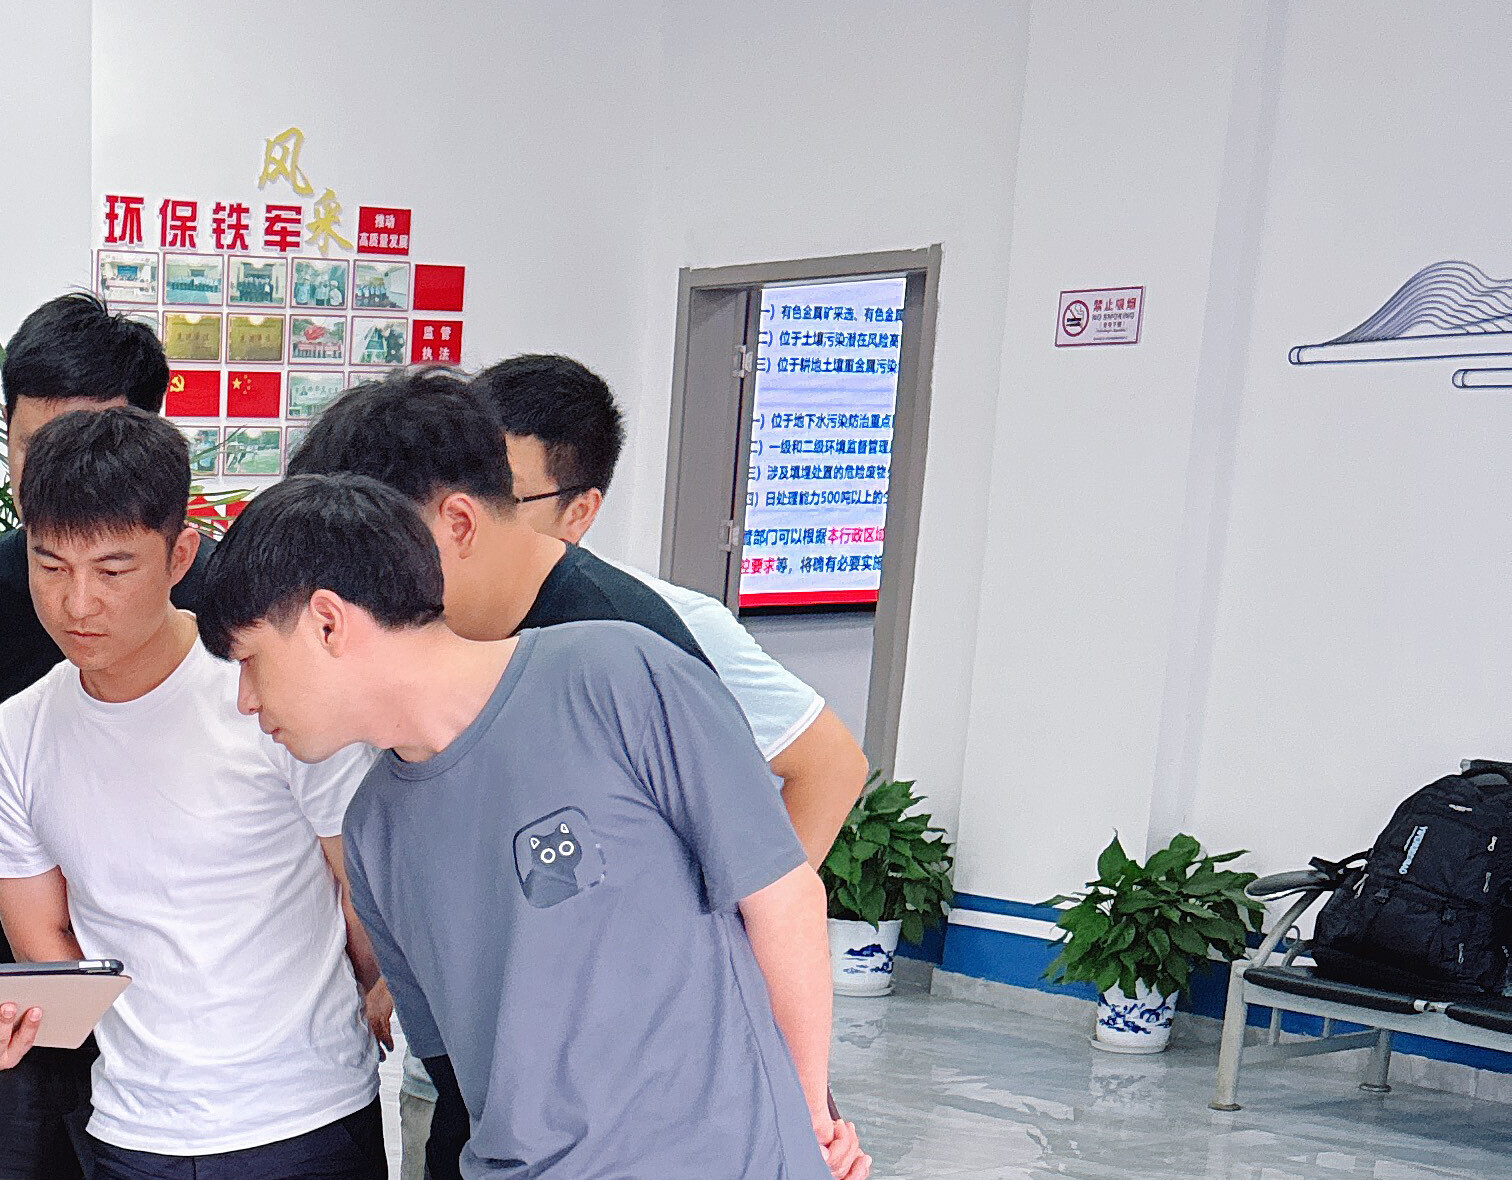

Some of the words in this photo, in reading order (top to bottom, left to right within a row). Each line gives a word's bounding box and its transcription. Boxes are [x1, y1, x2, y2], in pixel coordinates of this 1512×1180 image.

[105, 194, 302, 253] 环保铁军
[374, 213, 396, 229] 推动
[358, 232, 409, 249] 高质量发展
[1092, 297, 1137, 312] 禁止吸烟
[423, 325, 452, 341] 监管
[421, 346, 451, 361] 执法
[752, 413, 894, 429] 一）位于地下水污染防治重点
[750, 439, 893, 456] 二）一级和二级环境监督管理
[748, 465, 890, 481] 三）涉及填埋处置的危险废物
